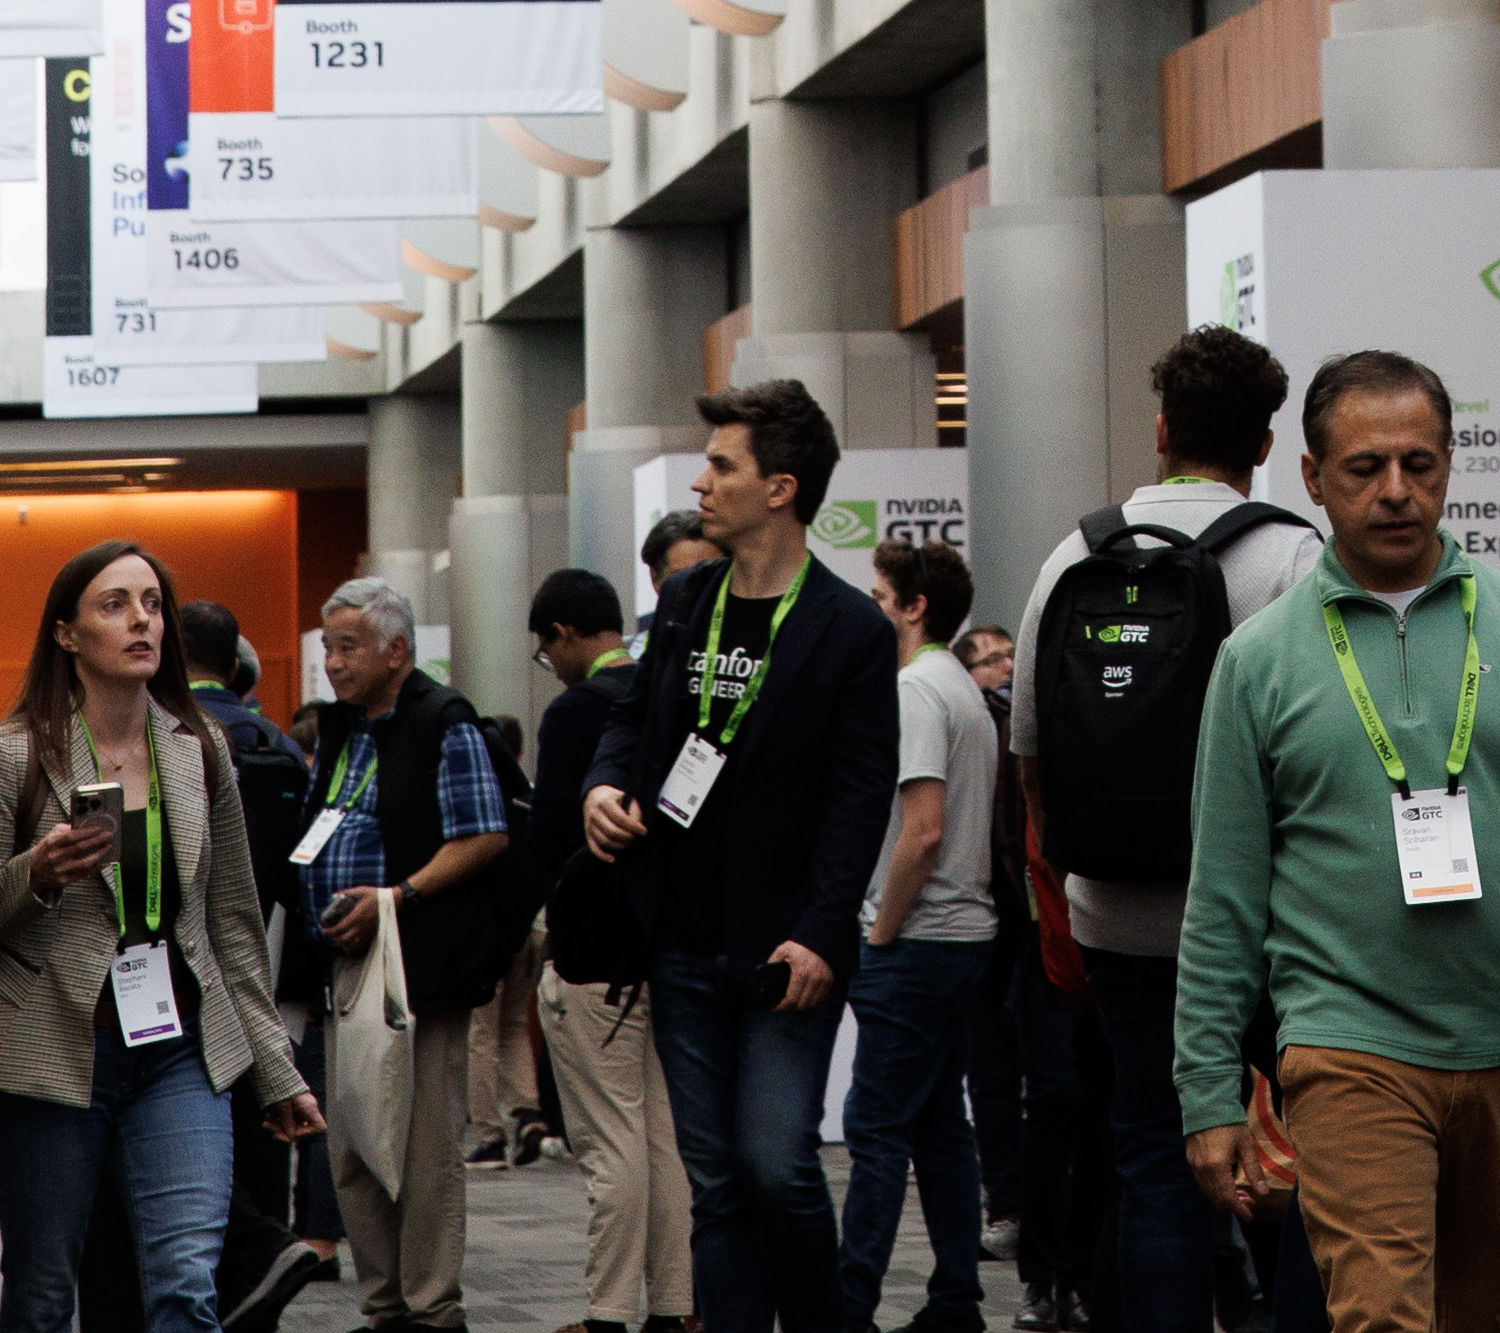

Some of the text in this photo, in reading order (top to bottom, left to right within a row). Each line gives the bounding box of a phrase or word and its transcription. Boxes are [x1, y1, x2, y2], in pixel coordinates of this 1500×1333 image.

[306, 19, 358, 34] Booth
[310, 41, 386, 68] 1231
[217, 137, 263, 151] Booth
[218, 157, 275, 181] 735
[170, 231, 211, 244] Booth
[174, 249, 239, 270] 1406
[116, 313, 157, 333] 731
[67, 367, 121, 387] 1607
[887, 498, 963, 515] NVIDIA
[1120, 632, 1149, 643] GTC
[1103, 665, 1133, 679] aws
[1421, 811, 1443, 820] GTC
